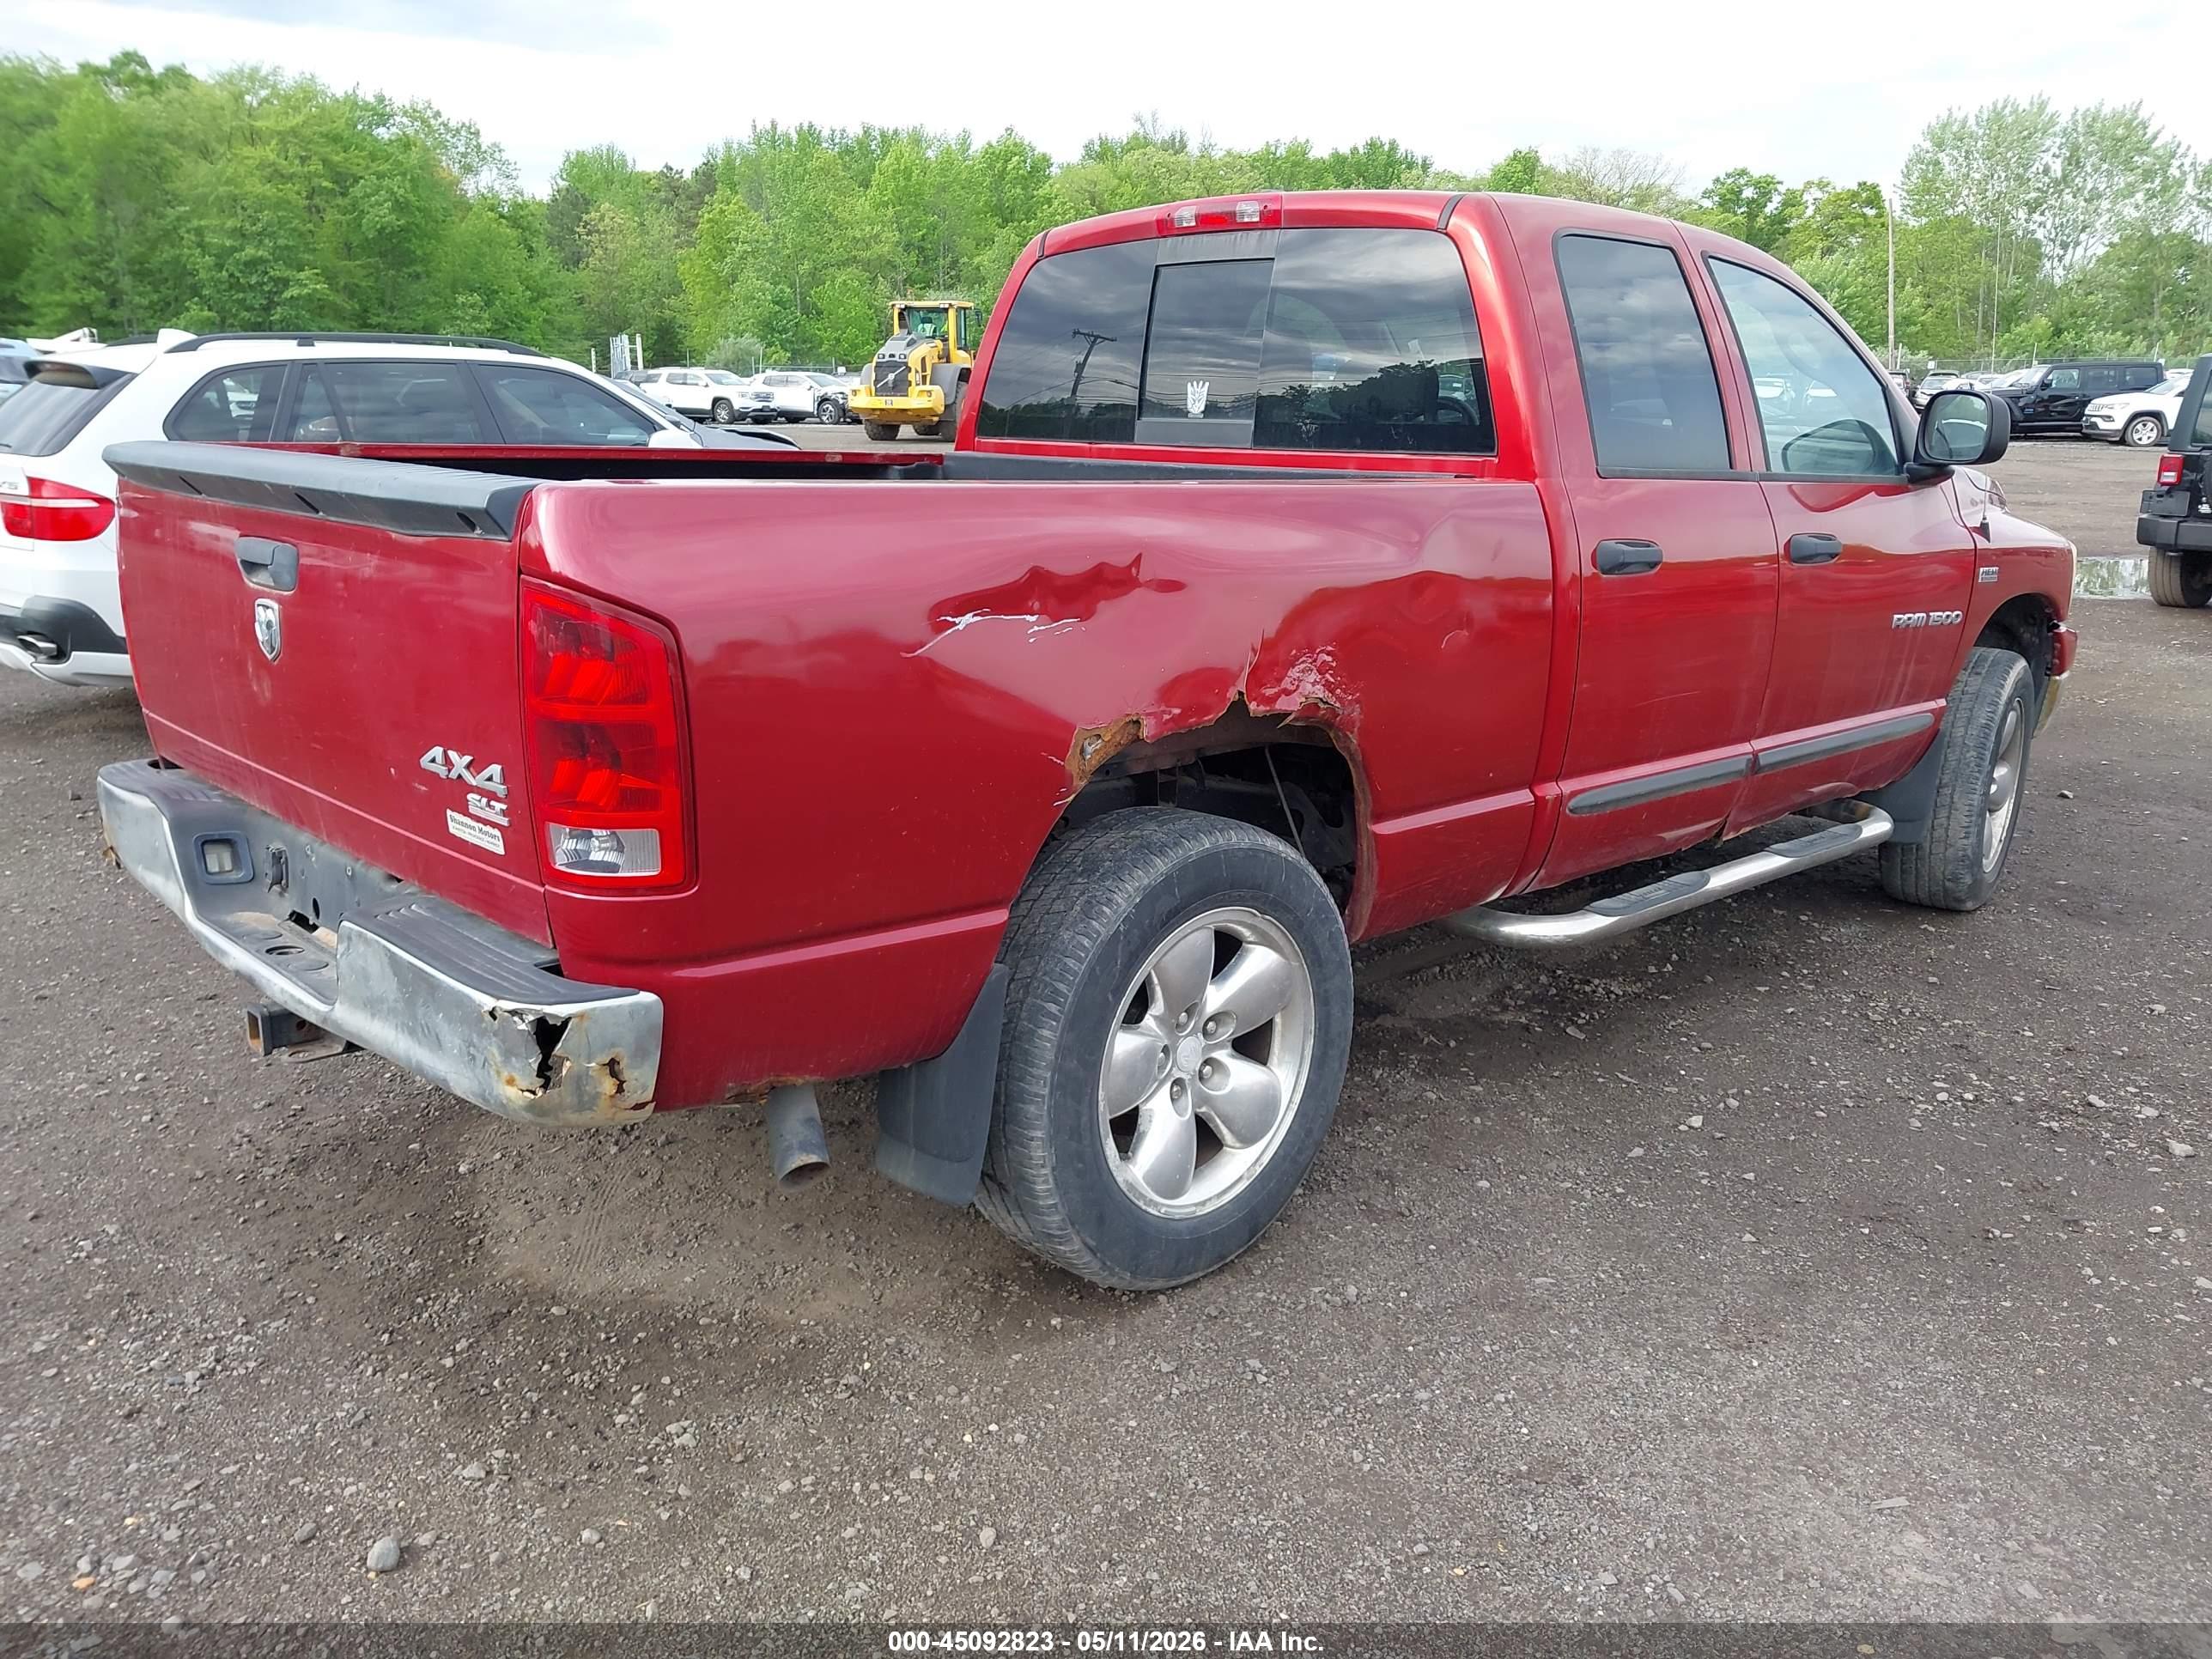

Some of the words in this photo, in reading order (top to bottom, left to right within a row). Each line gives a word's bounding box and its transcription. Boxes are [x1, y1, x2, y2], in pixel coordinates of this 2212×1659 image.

[1892, 613, 1927, 629] RAM
[1929, 611, 1963, 627] 1500
[466, 793, 508, 817] SLT
[449, 814, 477, 833] Shannon
[477, 825, 501, 842] Motors
